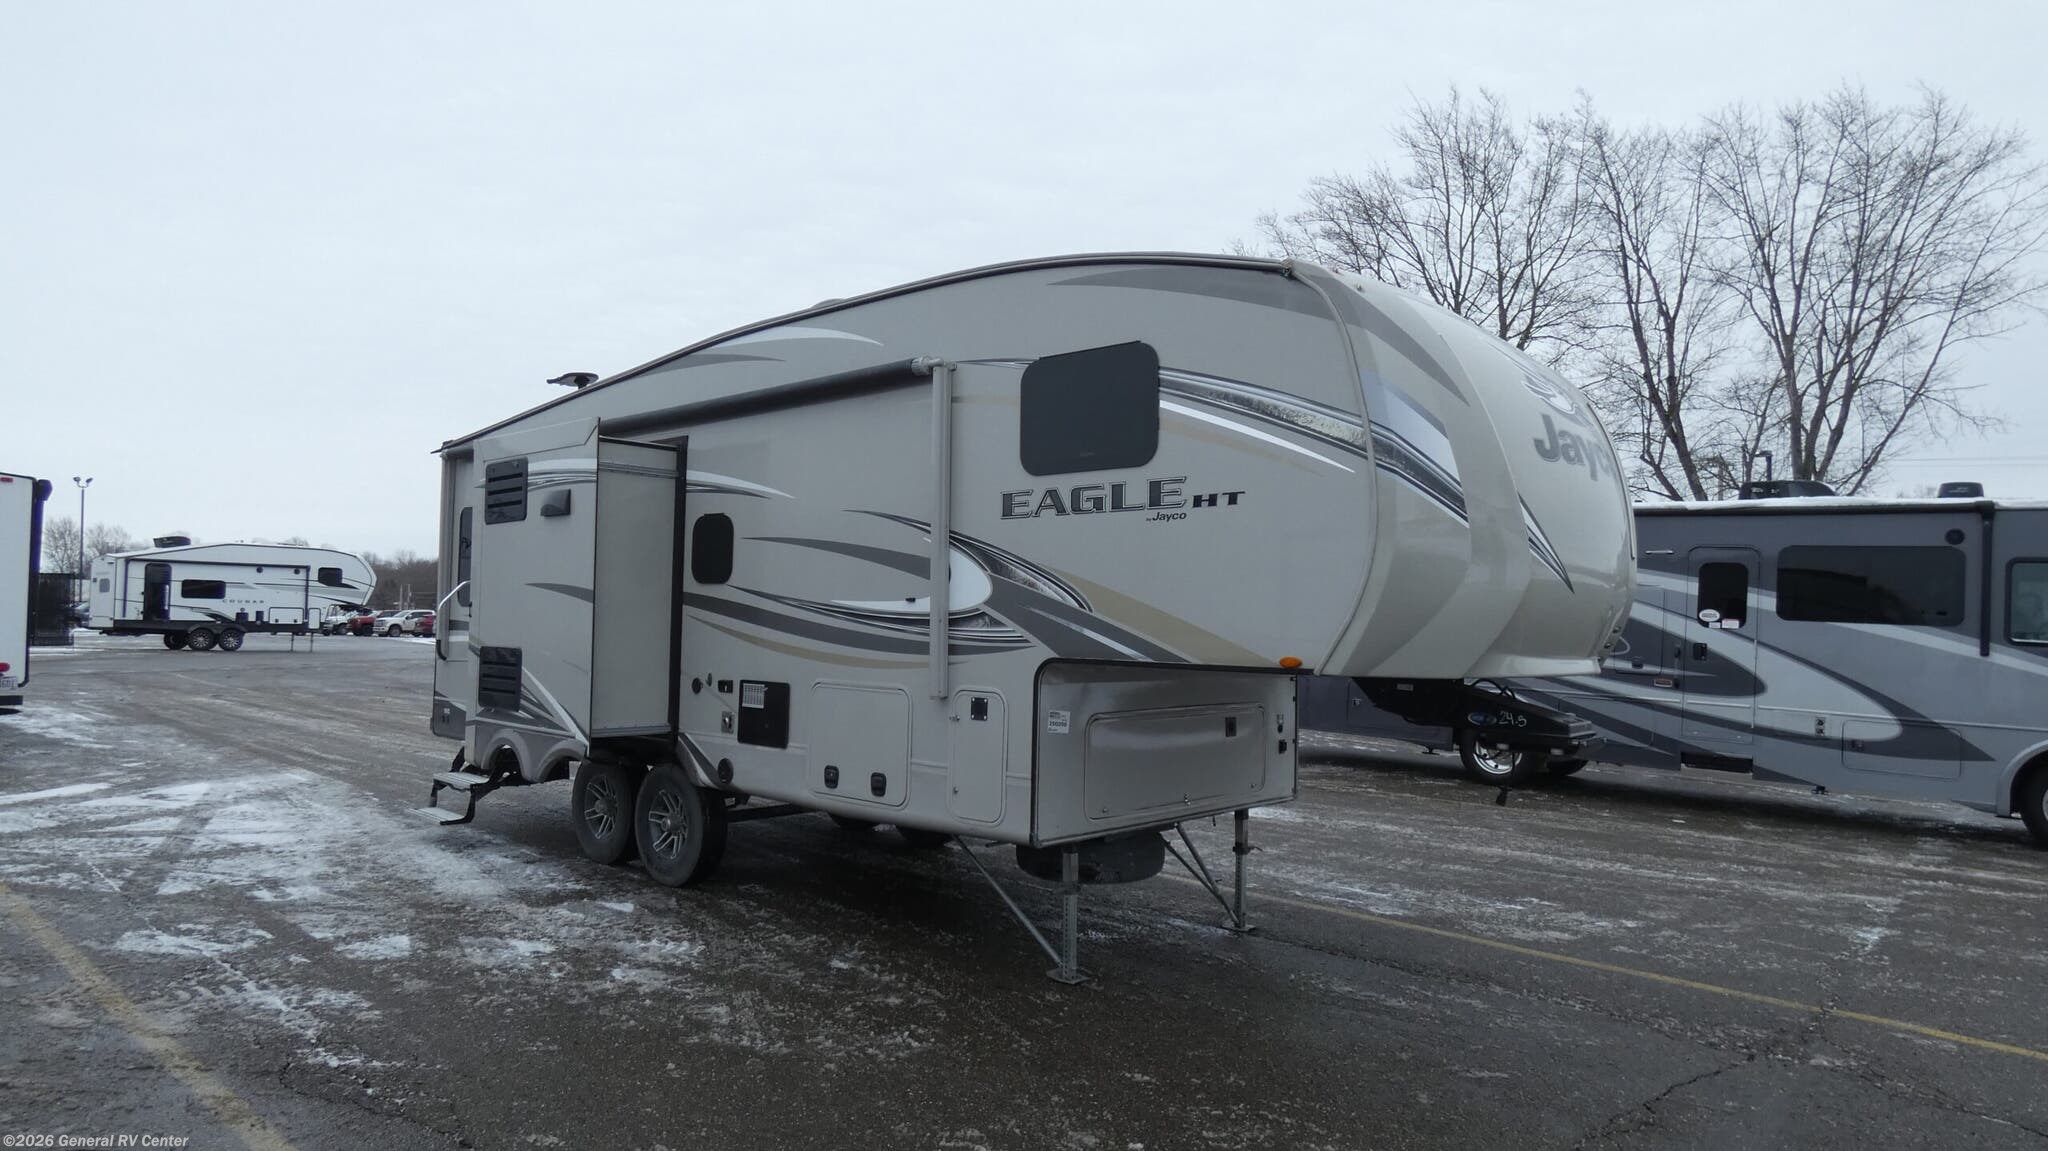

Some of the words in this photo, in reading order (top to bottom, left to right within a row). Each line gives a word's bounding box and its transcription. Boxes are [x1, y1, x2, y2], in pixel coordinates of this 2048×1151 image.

[1000, 476, 1187, 520] EAGLE
[1192, 490, 1246, 508] HT
[1152, 511, 1187, 523] Jayco
